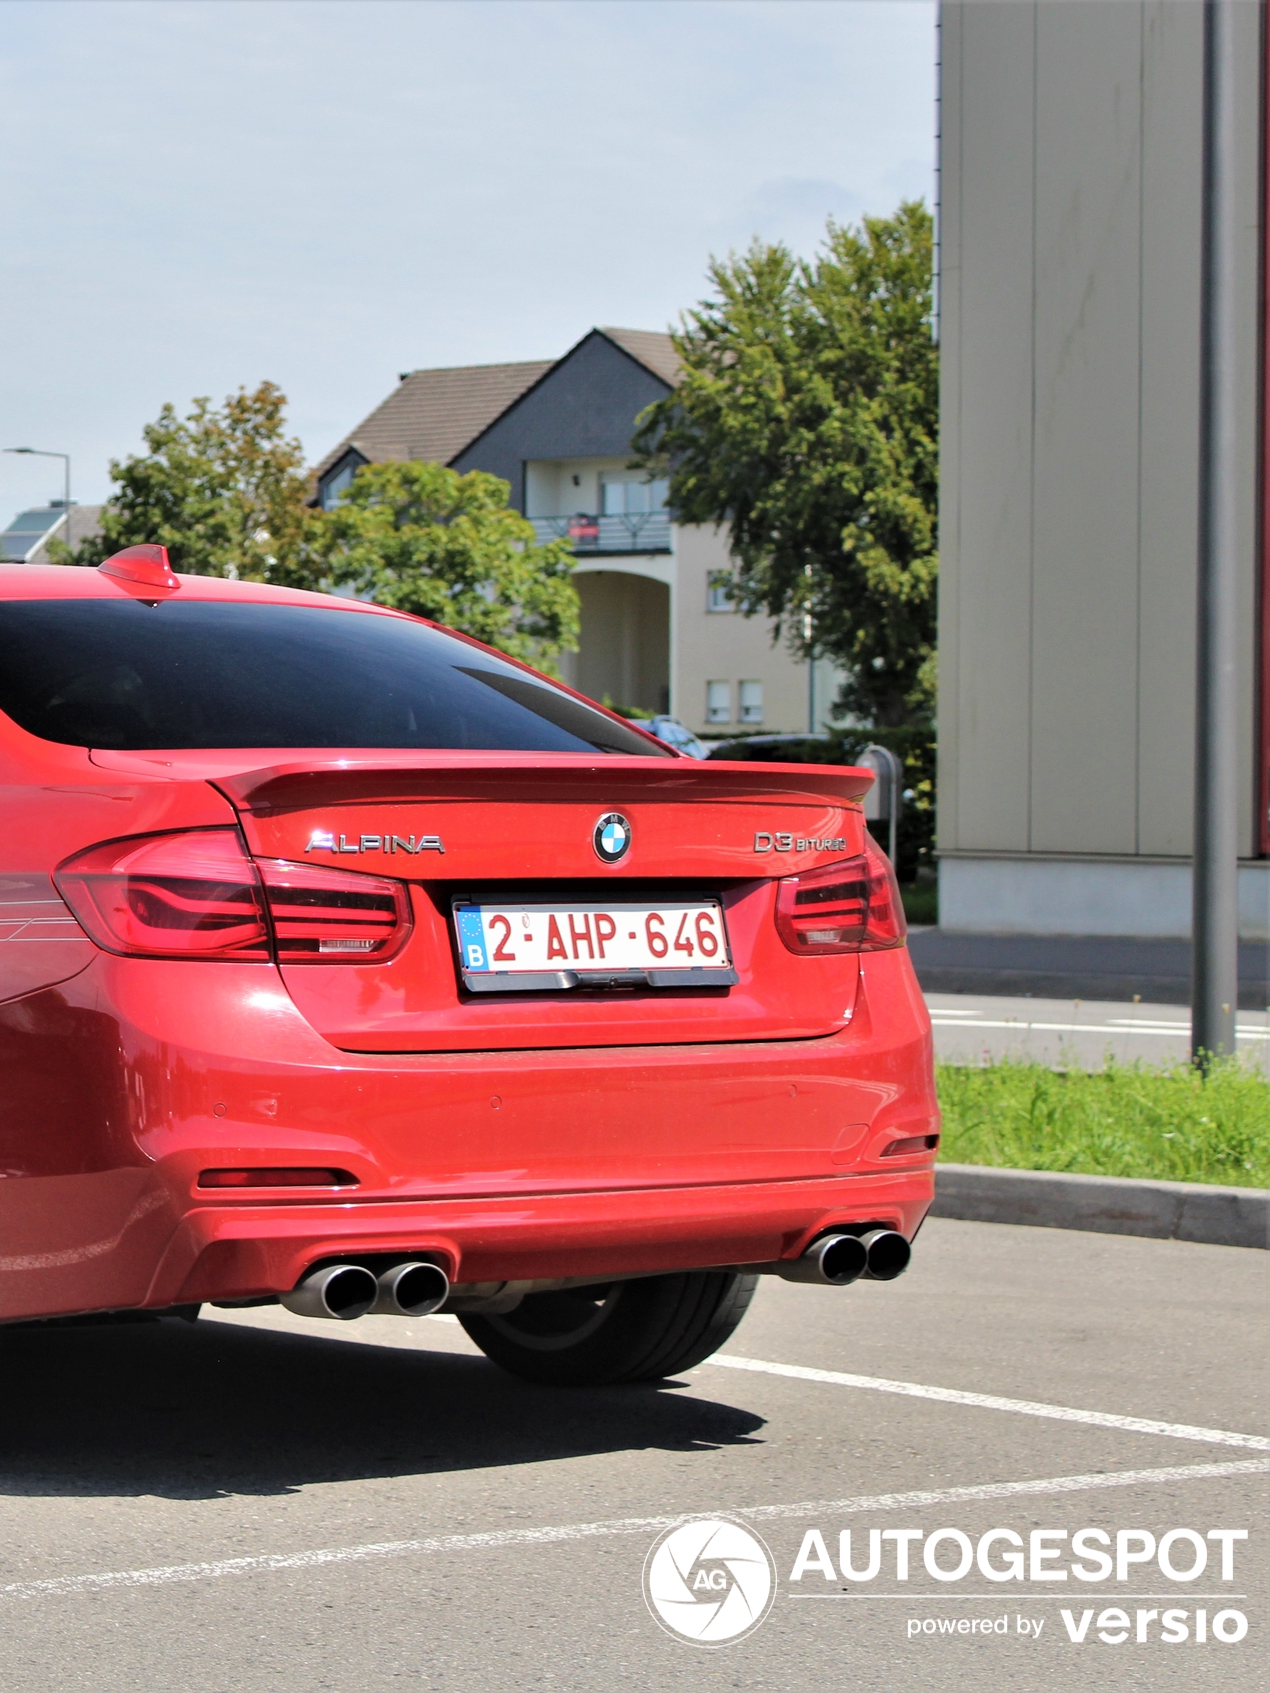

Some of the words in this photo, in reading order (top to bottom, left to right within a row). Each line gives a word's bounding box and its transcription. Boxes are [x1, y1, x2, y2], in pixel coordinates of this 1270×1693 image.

[598, 814, 629, 831] BMW
[304, 833, 446, 854] ALPINA
[754, 832, 793, 852] D3
[795, 838, 847, 852] BITURBO
[467, 944, 484, 967] B
